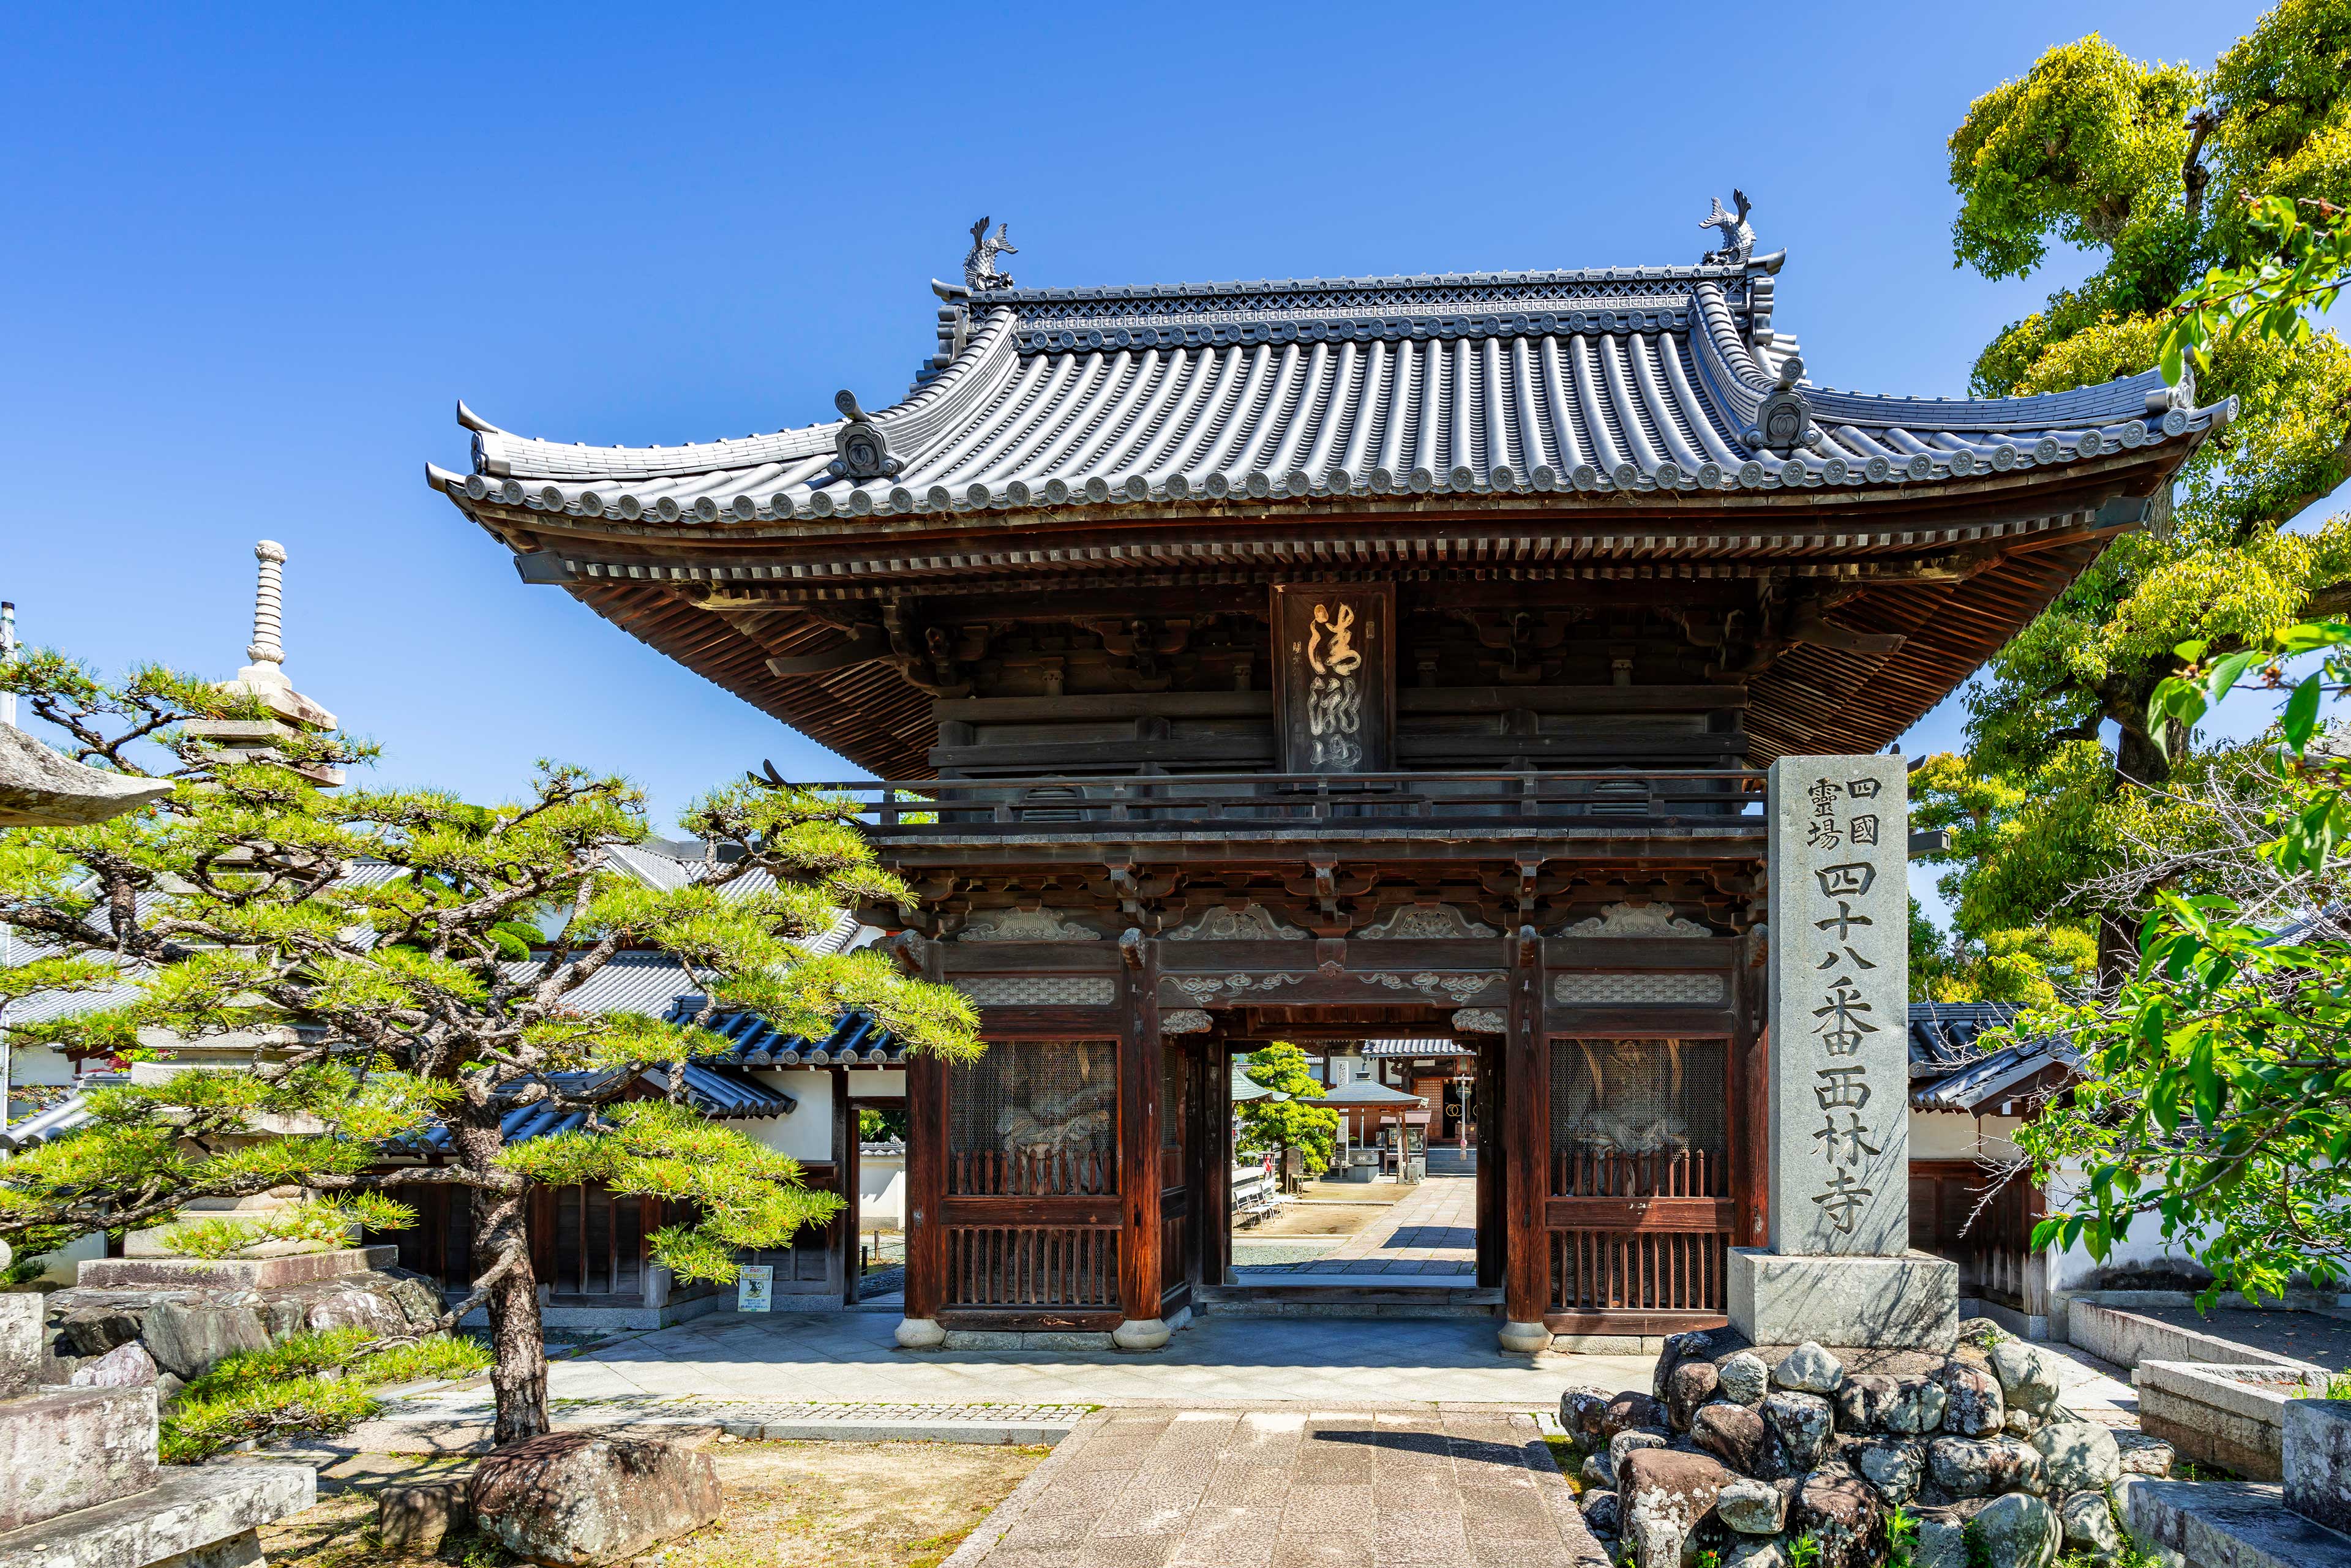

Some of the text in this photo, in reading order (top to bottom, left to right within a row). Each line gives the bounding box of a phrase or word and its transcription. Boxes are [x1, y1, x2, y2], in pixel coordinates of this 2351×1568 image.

[1806, 777, 1843, 851] 靈場
[1846, 778, 1882, 846] 四國
[1810, 862, 1881, 1234] 四十八番西林寺
